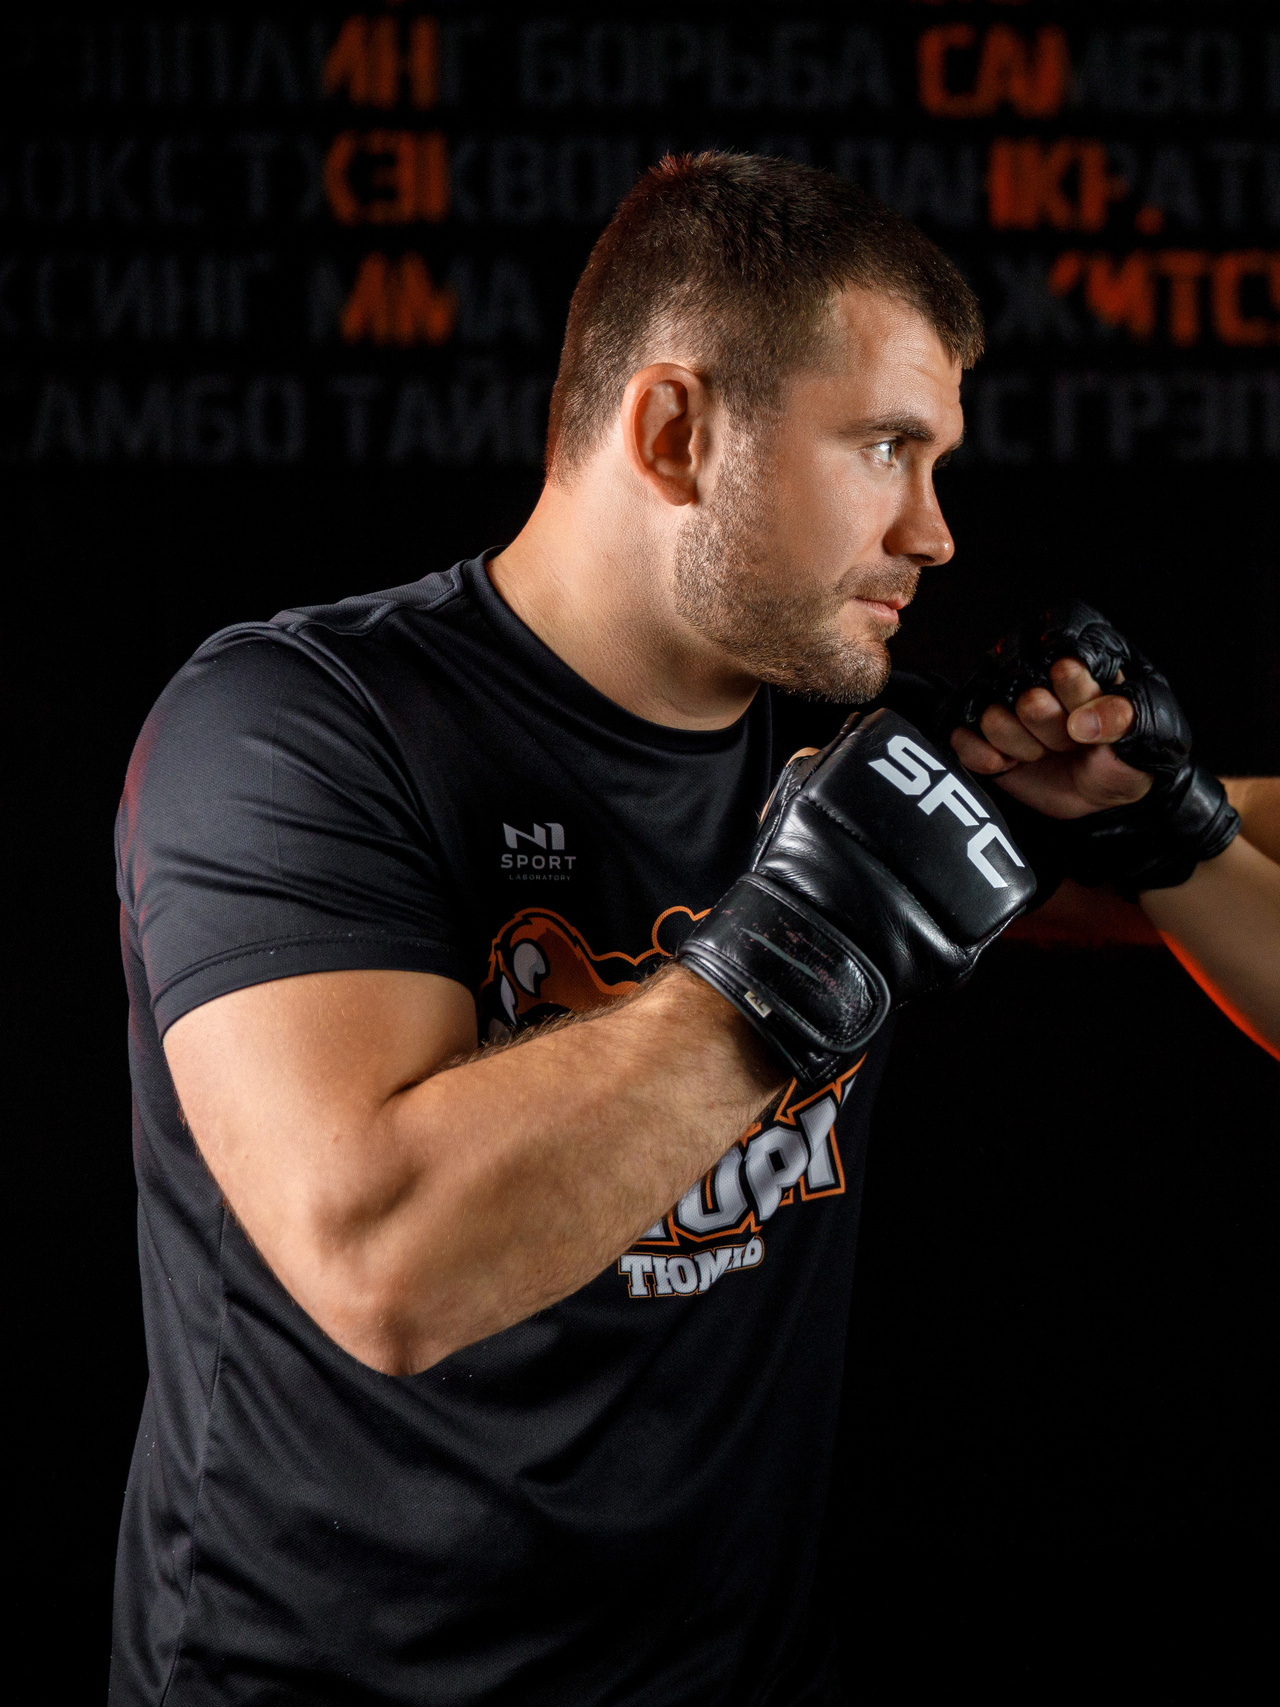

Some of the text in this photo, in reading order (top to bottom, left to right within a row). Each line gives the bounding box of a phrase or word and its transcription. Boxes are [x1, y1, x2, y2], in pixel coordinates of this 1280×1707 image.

[517, 18, 896, 112] БОРЬБА
[914, 22, 1244, 119] САМБО
[0, 132, 206, 222] ОКС
[305, 248, 545, 346] ММА
[868, 735, 1026, 889] SFC
[499, 853, 577, 871] SPORT
[508, 874, 571, 882] LABORATORY
